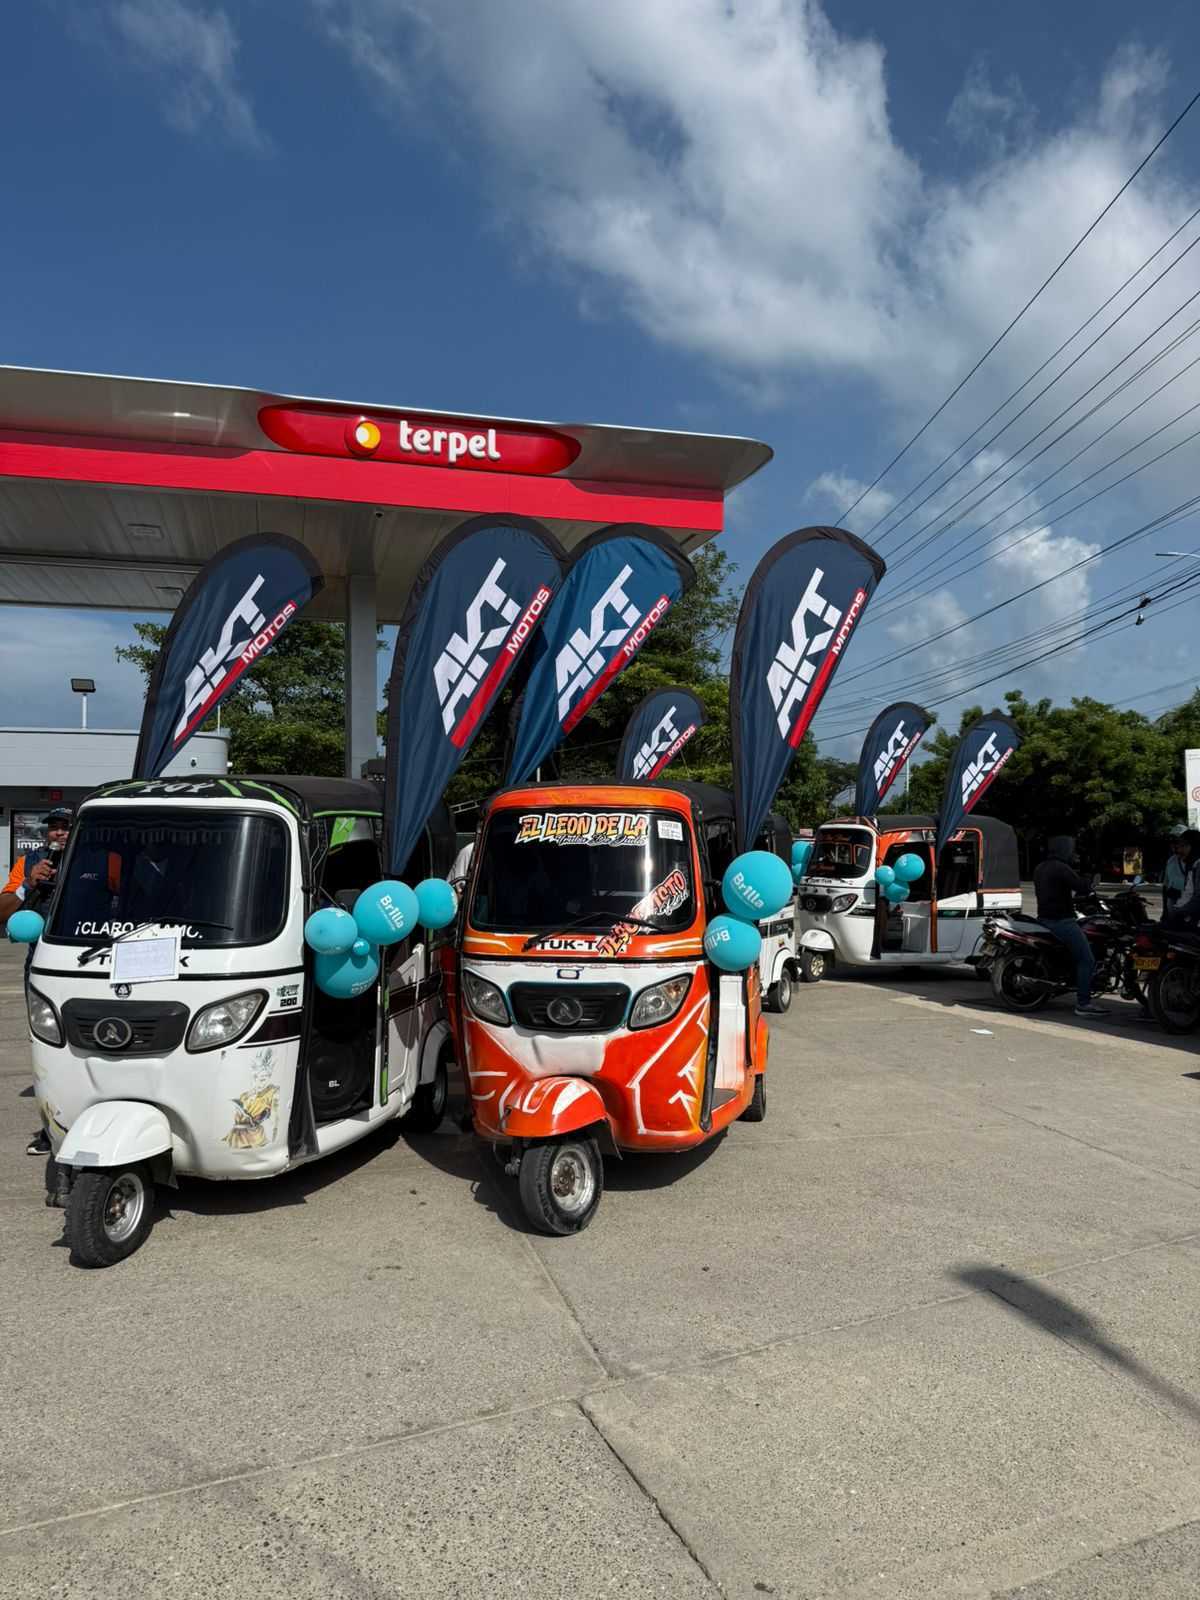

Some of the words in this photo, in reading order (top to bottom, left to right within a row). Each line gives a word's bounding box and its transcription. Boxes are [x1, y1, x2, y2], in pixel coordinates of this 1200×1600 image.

[400, 420, 501, 463] terpel
[241, 603, 297, 664] MOTOS
[433, 557, 522, 736] AKT
[506, 588, 550, 655] MOTOS
[555, 564, 642, 722] AKT
[623, 597, 668, 657] MOTOS
[766, 567, 843, 740] AKT
[831, 591, 867, 655] MOTOS
[174, 574, 266, 741] AKT
[632, 705, 680, 780] AKT
[667, 724, 697, 757] MOTOS
[873, 719, 910, 792] AKT
[961, 731, 1001, 806] AKT
[518, 815, 543, 839] EL
[544, 813, 592, 838] LEON
[595, 814, 619, 837] DE
[623, 814, 649, 837] LA
[379, 893, 405, 929] Brilla
[731, 871, 765, 909] Brilla
